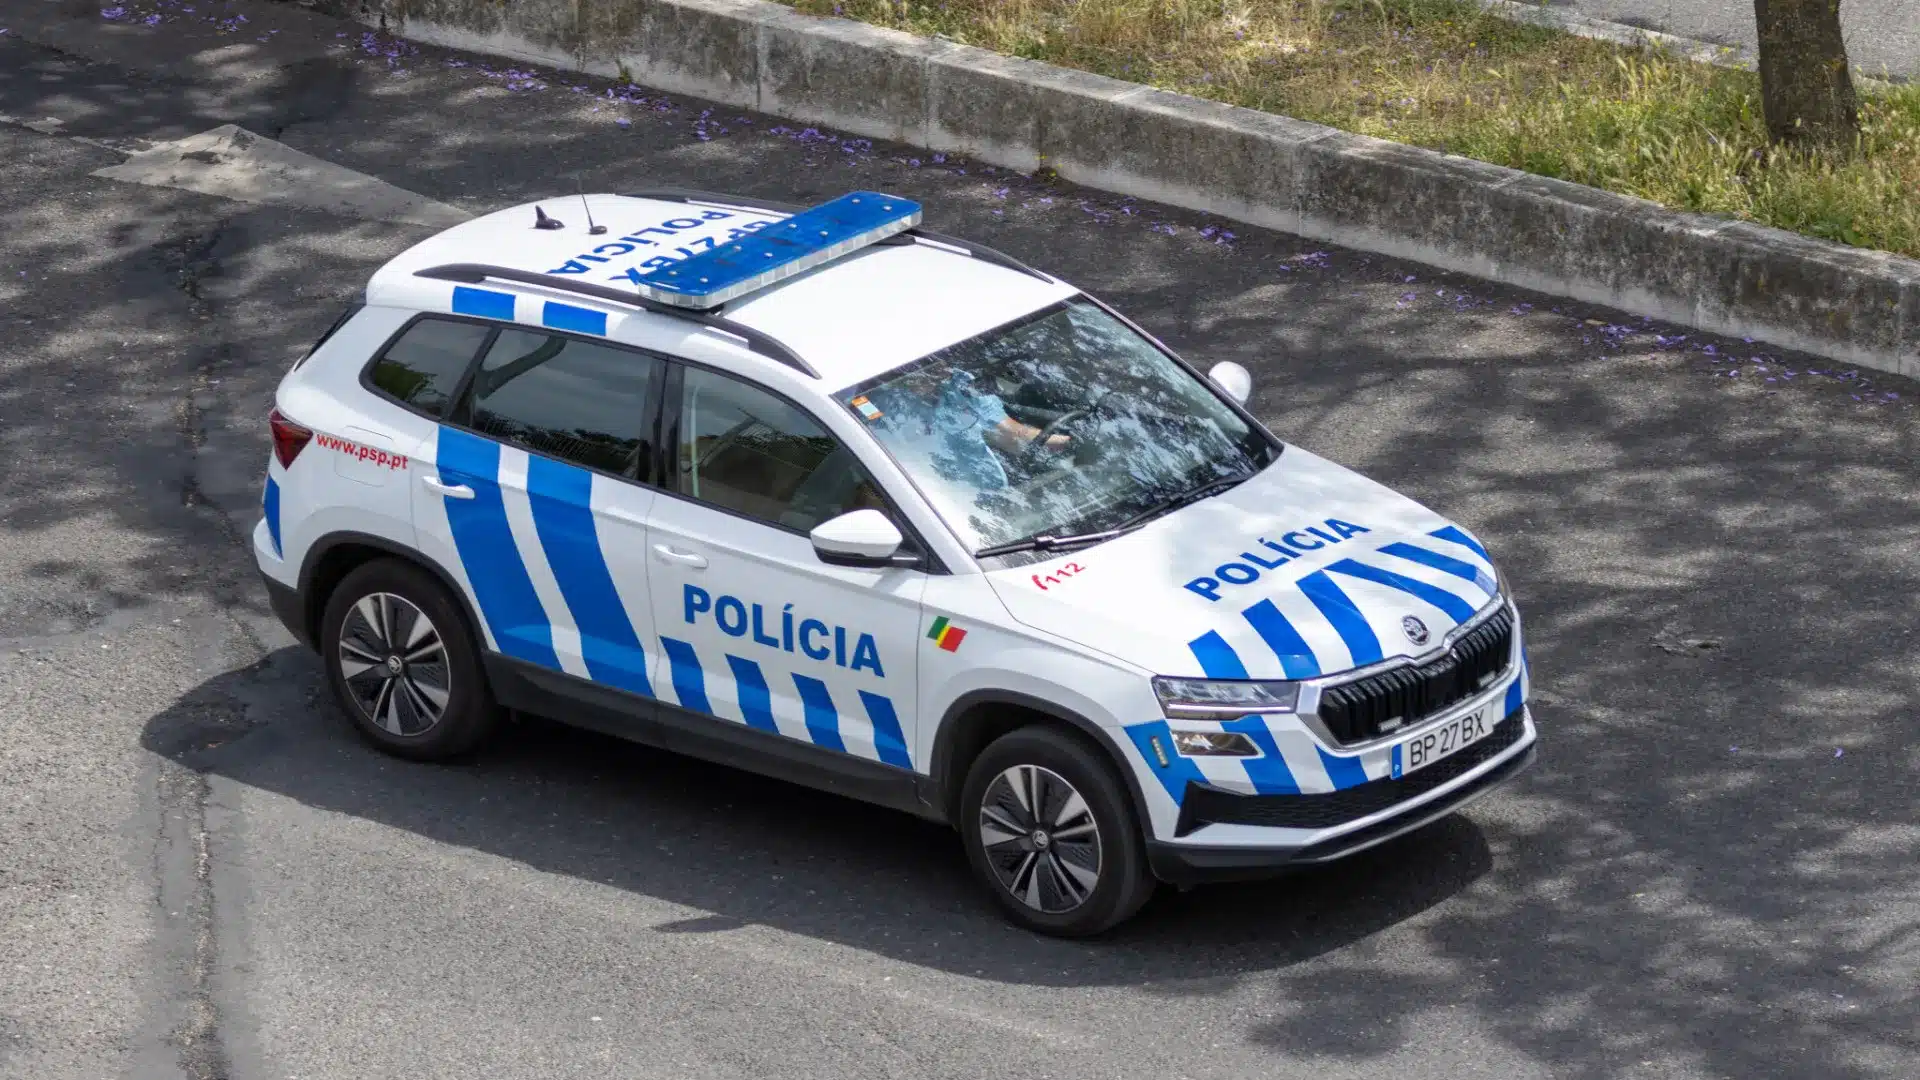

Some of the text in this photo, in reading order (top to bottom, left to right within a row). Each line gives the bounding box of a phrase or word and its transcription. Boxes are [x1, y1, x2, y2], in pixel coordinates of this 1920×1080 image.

[545, 210, 735, 275] POLÍCIA
[316, 434, 409, 469] www.psp.pt
[1045, 562, 1086, 584] 112
[1183, 518, 1372, 602] POLÍCIA
[683, 583, 885, 678] POLÍCIA
[1410, 708, 1485, 767] BP 27 BX
